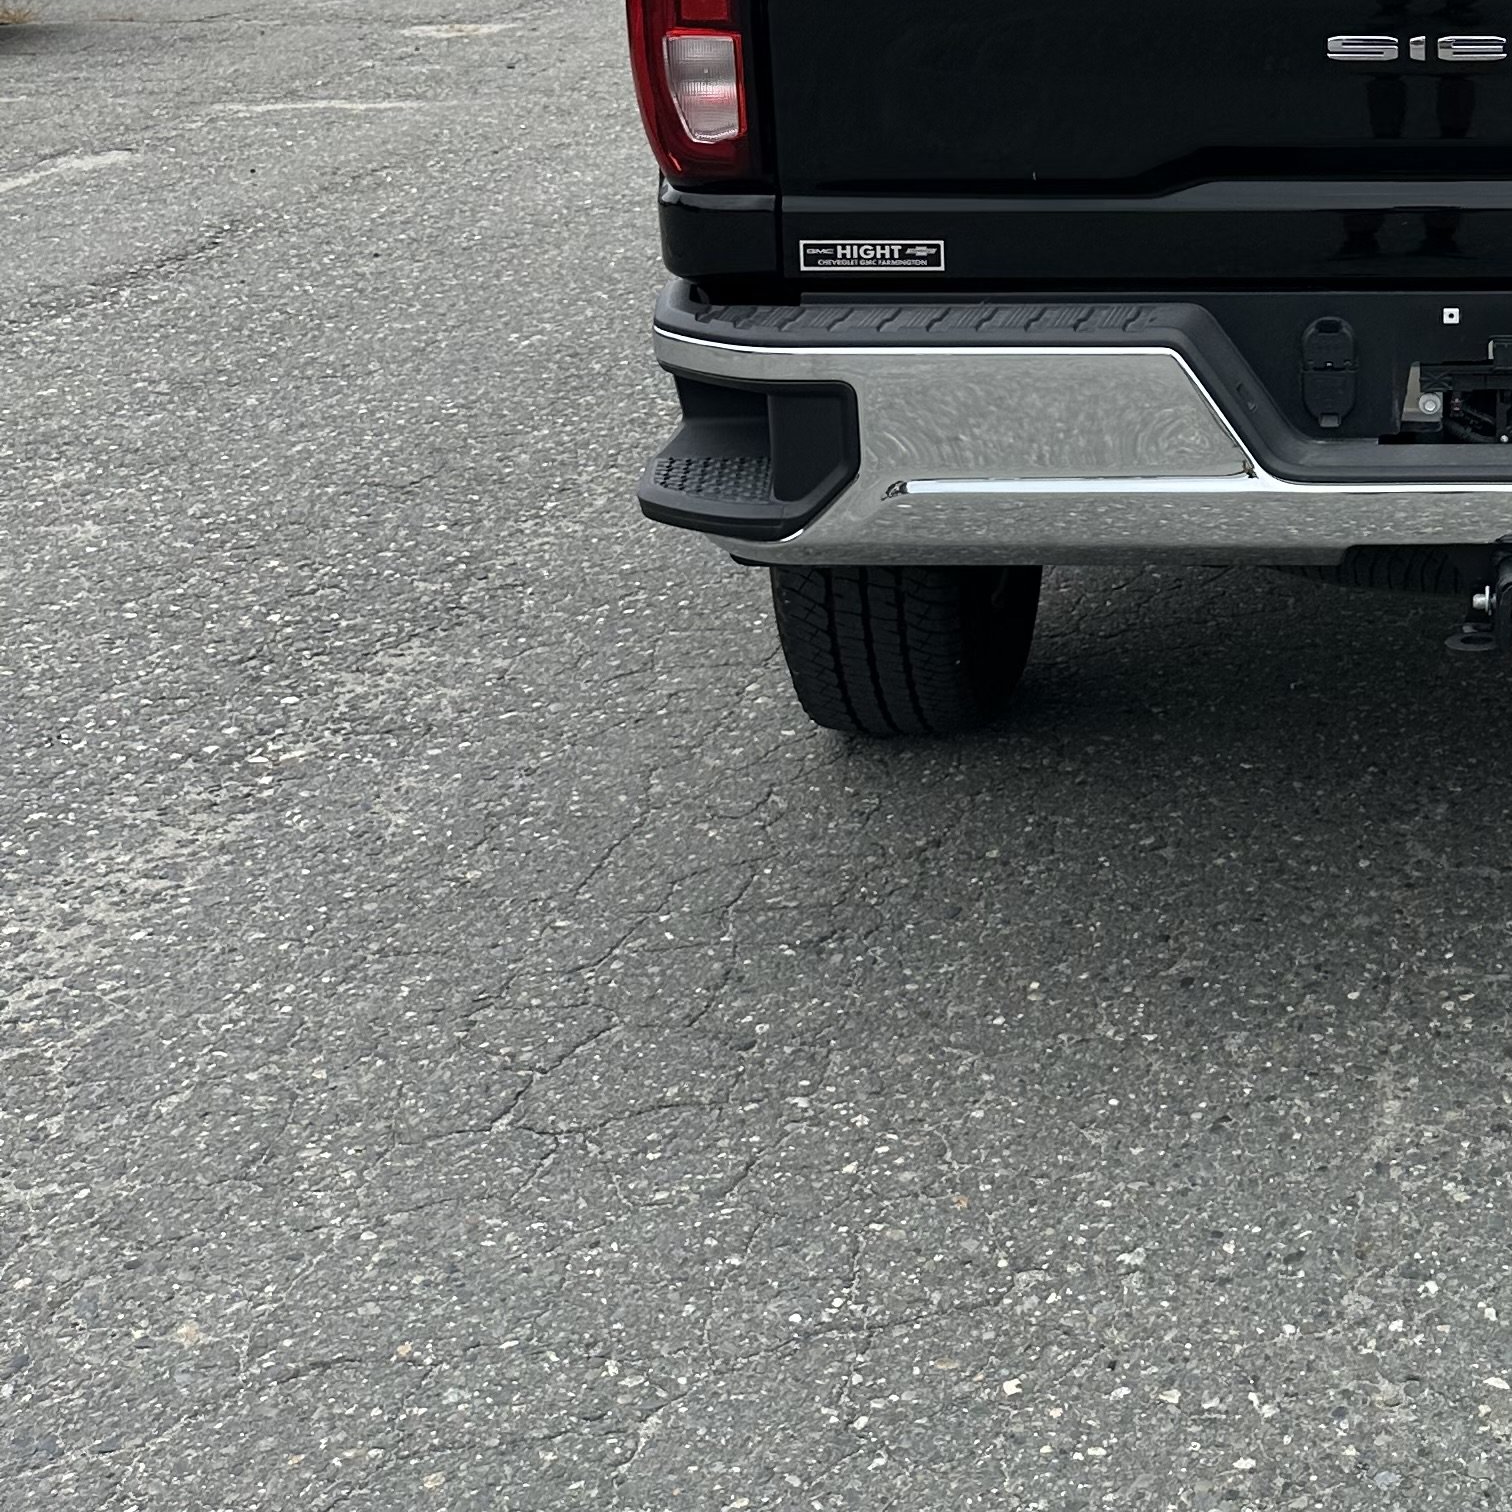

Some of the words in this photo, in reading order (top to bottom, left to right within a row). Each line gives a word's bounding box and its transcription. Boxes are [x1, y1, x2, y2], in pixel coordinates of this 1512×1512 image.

[836, 244, 902, 259] HIGHT
[817, 258, 858, 266] CHEVROLET
[859, 258, 877, 266] GMC
[877, 258, 928, 266] FARMINGTON
